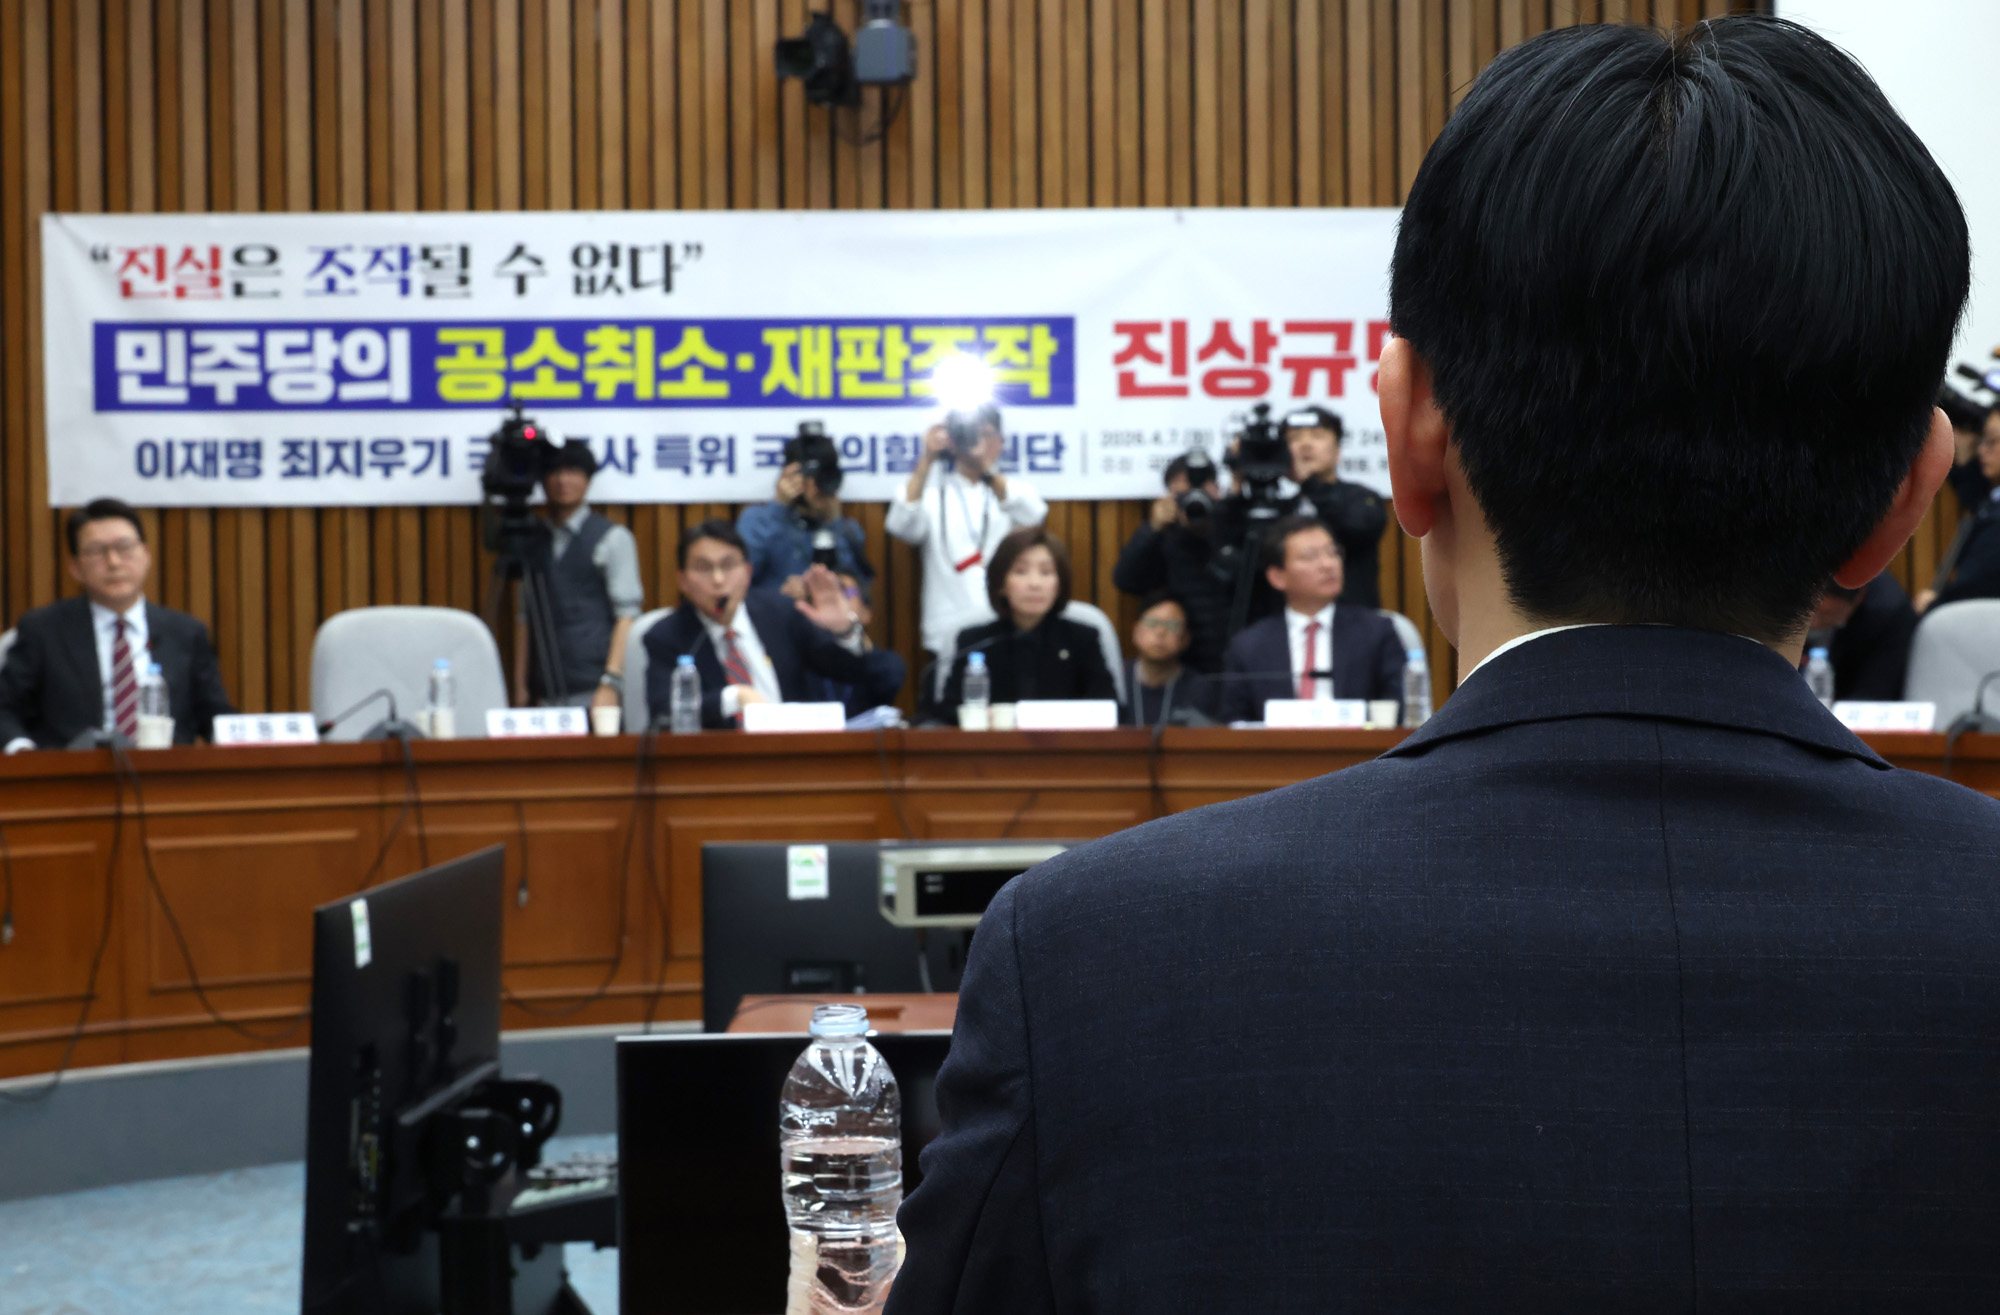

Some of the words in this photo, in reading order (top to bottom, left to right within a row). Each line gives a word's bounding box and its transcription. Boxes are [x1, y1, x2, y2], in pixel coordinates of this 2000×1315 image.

[304, 243, 471, 298] 조작될
[495, 243, 547, 296] 수
[114, 328, 411, 404] 민주당의
[134, 437, 264, 480] 이재명
[279, 436, 451, 479] 죄지우기
[654, 435, 737, 476] 특위
